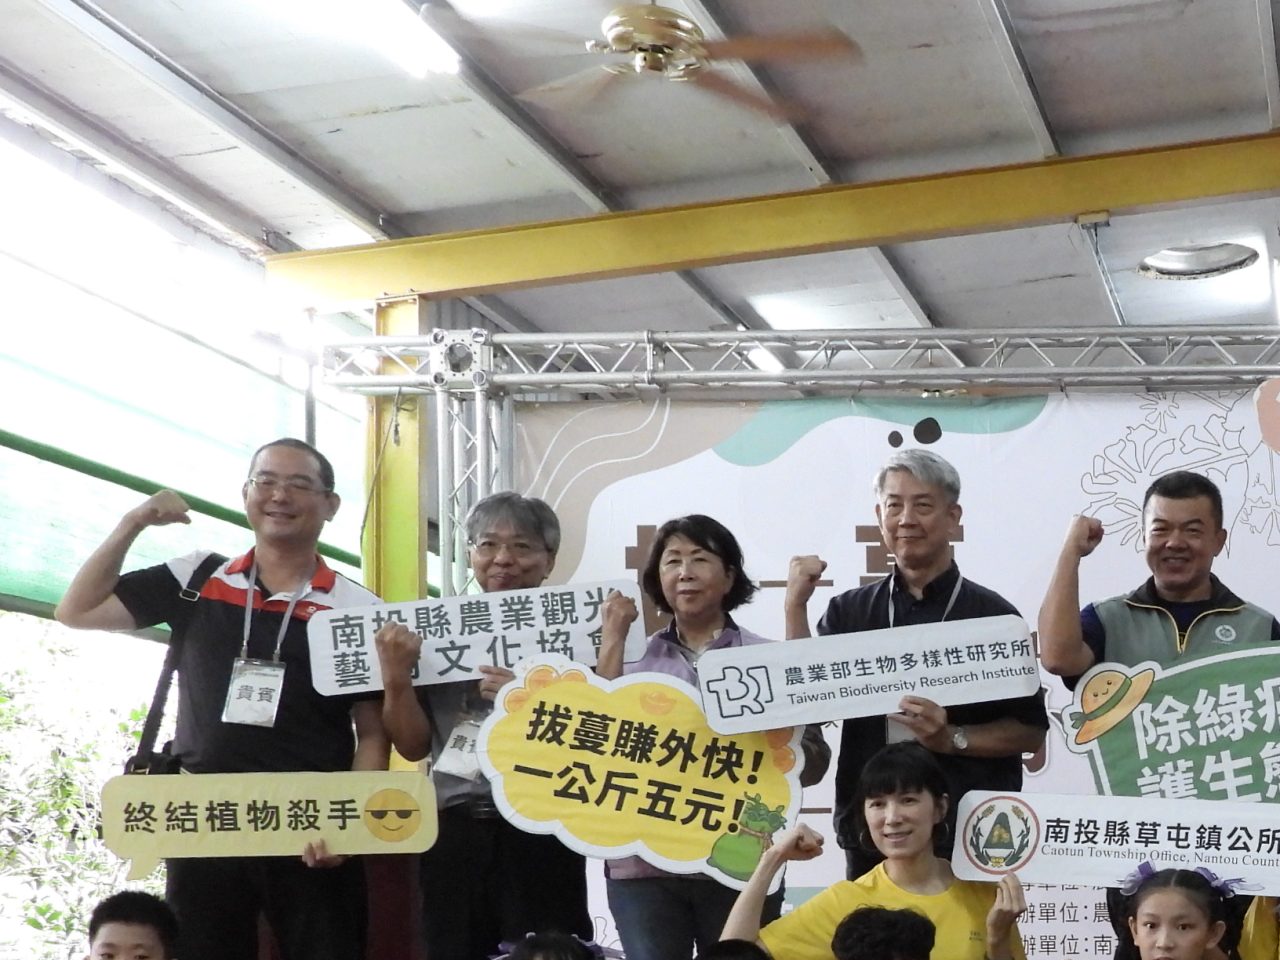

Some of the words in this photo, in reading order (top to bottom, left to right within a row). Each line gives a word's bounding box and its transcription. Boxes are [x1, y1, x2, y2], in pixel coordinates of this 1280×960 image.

[785, 639, 1030, 686] 農業部生物多樣性研究所
[236, 685, 276, 703] 貴賓
[787, 691, 836, 705] Taiwan
[840, 680, 916, 698] Biodiversity
[920, 672, 978, 687] Research
[982, 666, 1035, 680] Institute
[526, 700, 764, 786] 拔蔓賺外快!
[123, 798, 361, 834] 終結植物殺手
[513, 760, 745, 833] 一公斤五元!
[1041, 845, 1084, 857] Caotun
[1088, 847, 1147, 863] Township
[1150, 850, 1190, 863] Office,
[1194, 852, 1238, 866] Nantou
